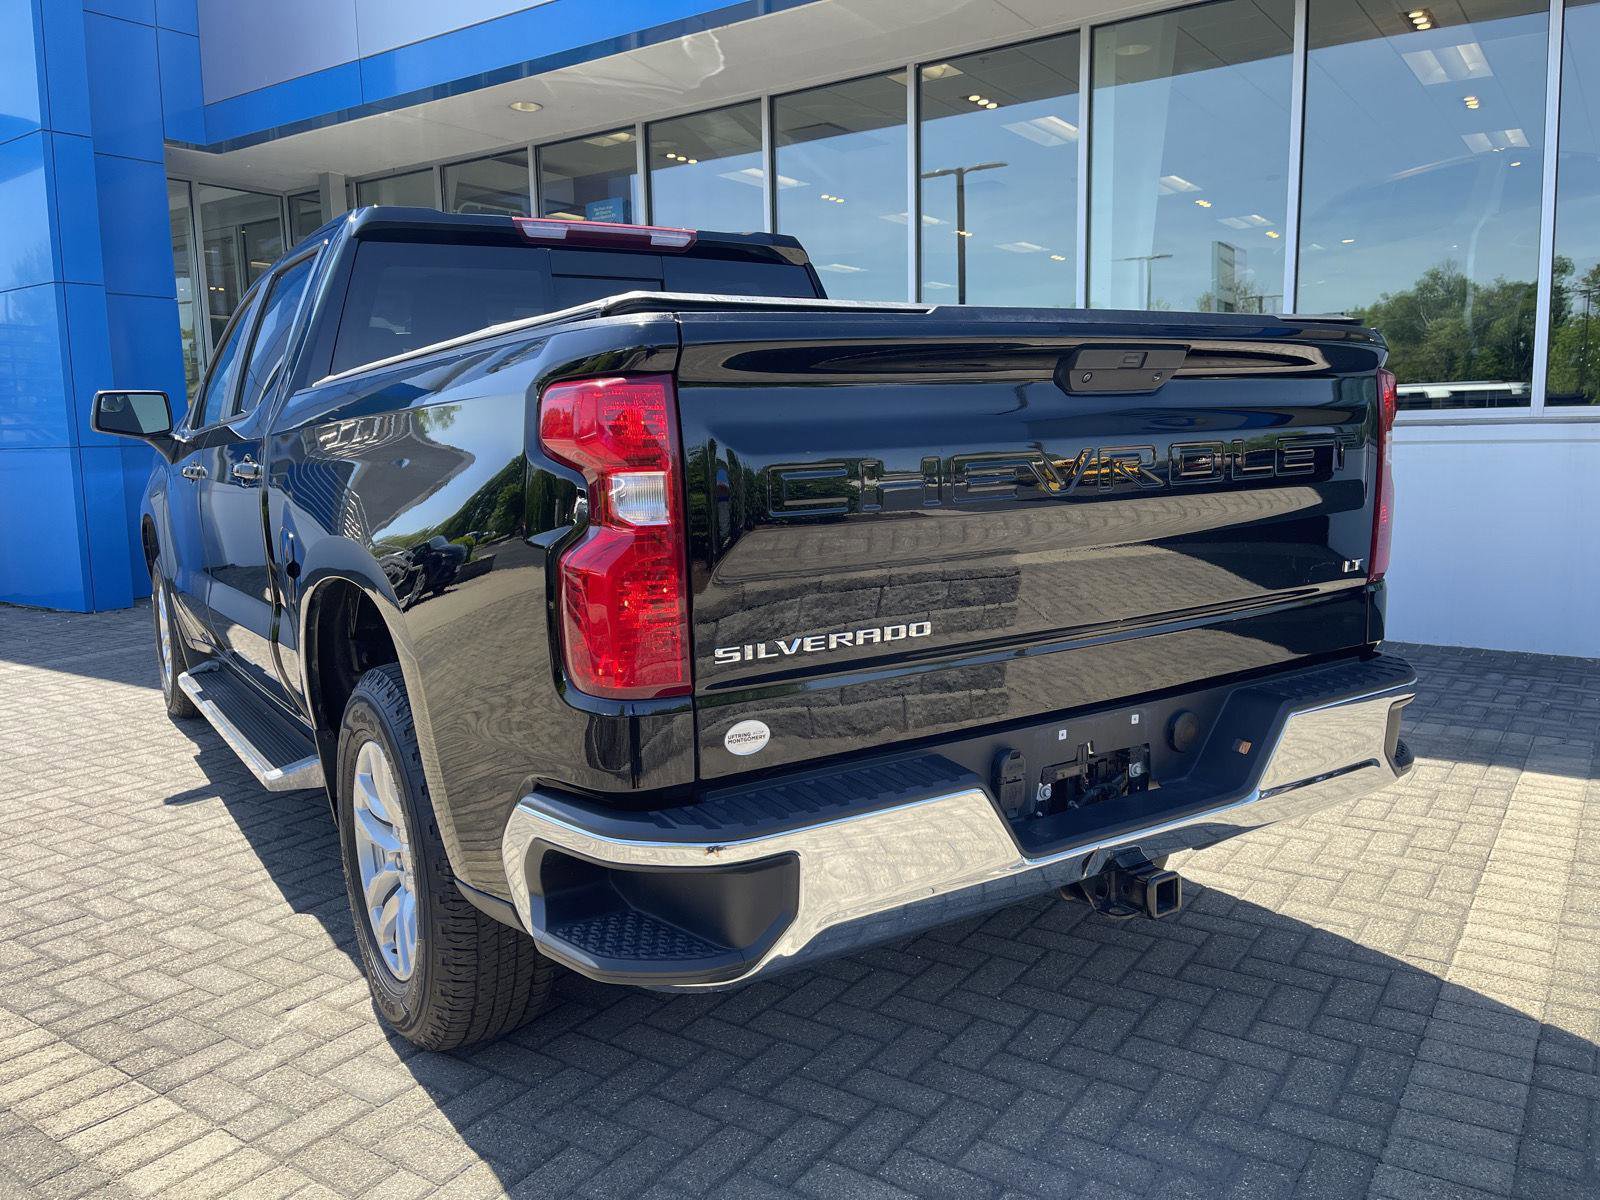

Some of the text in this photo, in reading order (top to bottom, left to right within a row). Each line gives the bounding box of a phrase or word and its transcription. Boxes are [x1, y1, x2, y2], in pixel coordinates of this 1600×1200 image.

[768, 432, 1357, 517] CHEVROLET
[1344, 558, 1364, 573] LT
[714, 620, 932, 665] SILVERADO
[727, 734, 766, 745] MONTGOMERY
